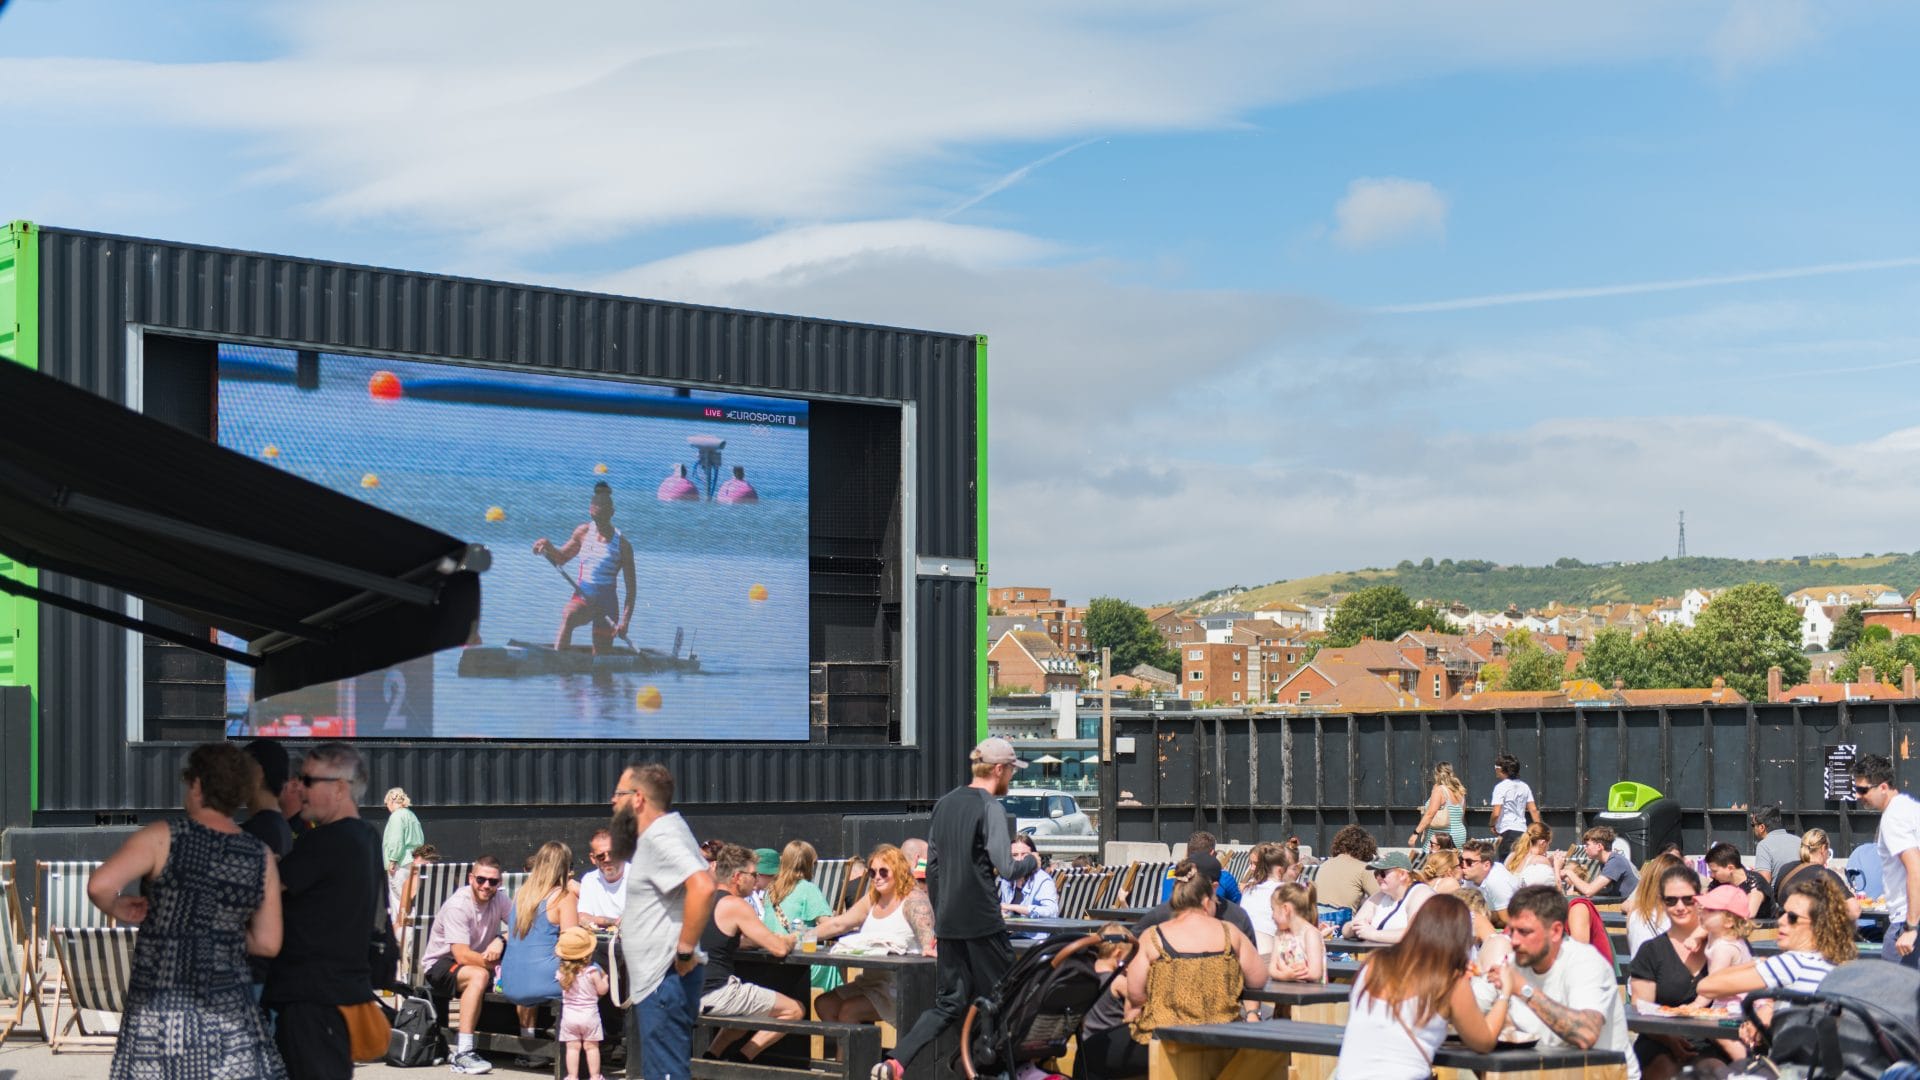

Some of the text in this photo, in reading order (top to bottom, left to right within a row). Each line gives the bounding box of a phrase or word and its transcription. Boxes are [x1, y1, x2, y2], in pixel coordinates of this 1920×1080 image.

[705, 408, 721, 417] LIVE
[728, 410, 787, 424] EUROSPORT
[383, 669, 407, 730] 2
